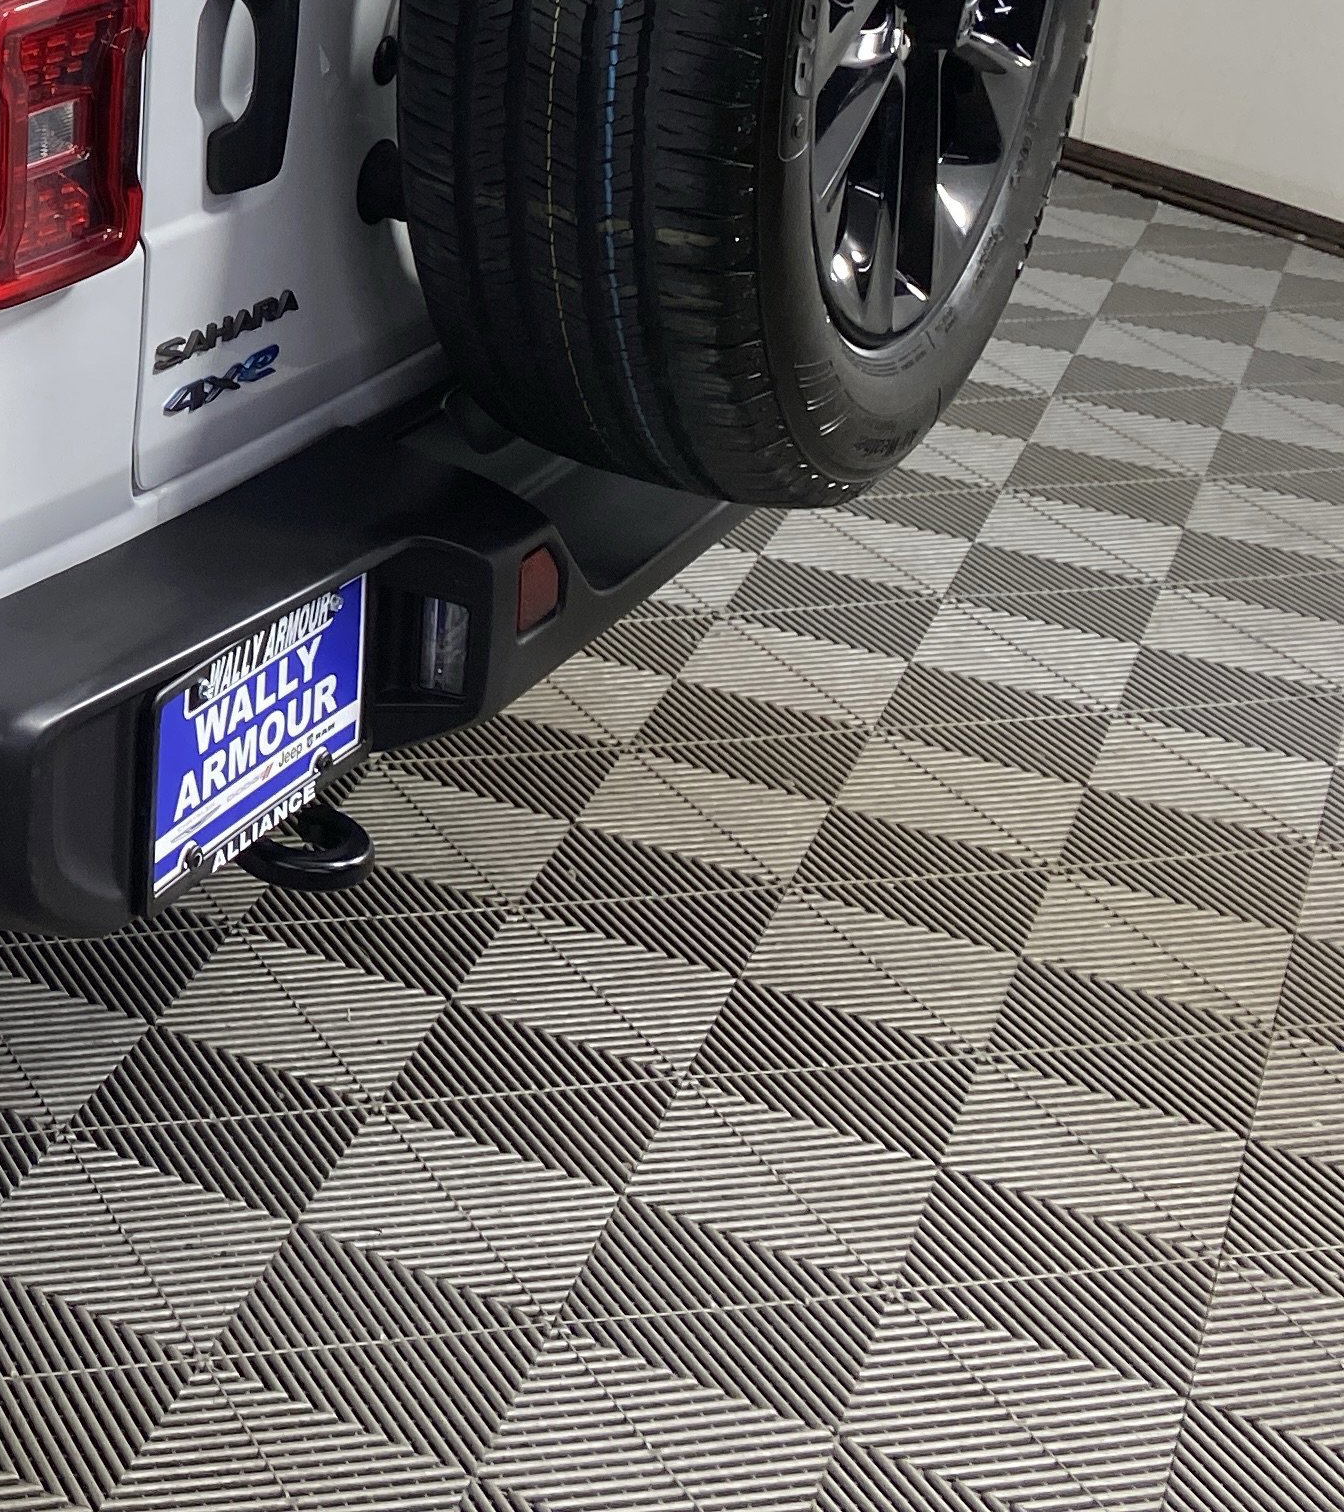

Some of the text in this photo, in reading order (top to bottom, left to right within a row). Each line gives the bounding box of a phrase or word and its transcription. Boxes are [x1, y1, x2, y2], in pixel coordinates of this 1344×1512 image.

[153, 288, 300, 376] SAHARA
[208, 591, 332, 696] WALLY ARMOUR
[194, 634, 323, 756] WALLY
[172, 673, 339, 823] ARMOUR
[277, 742, 303, 768] Jeep
[211, 779, 317, 874] ALLIANCE
